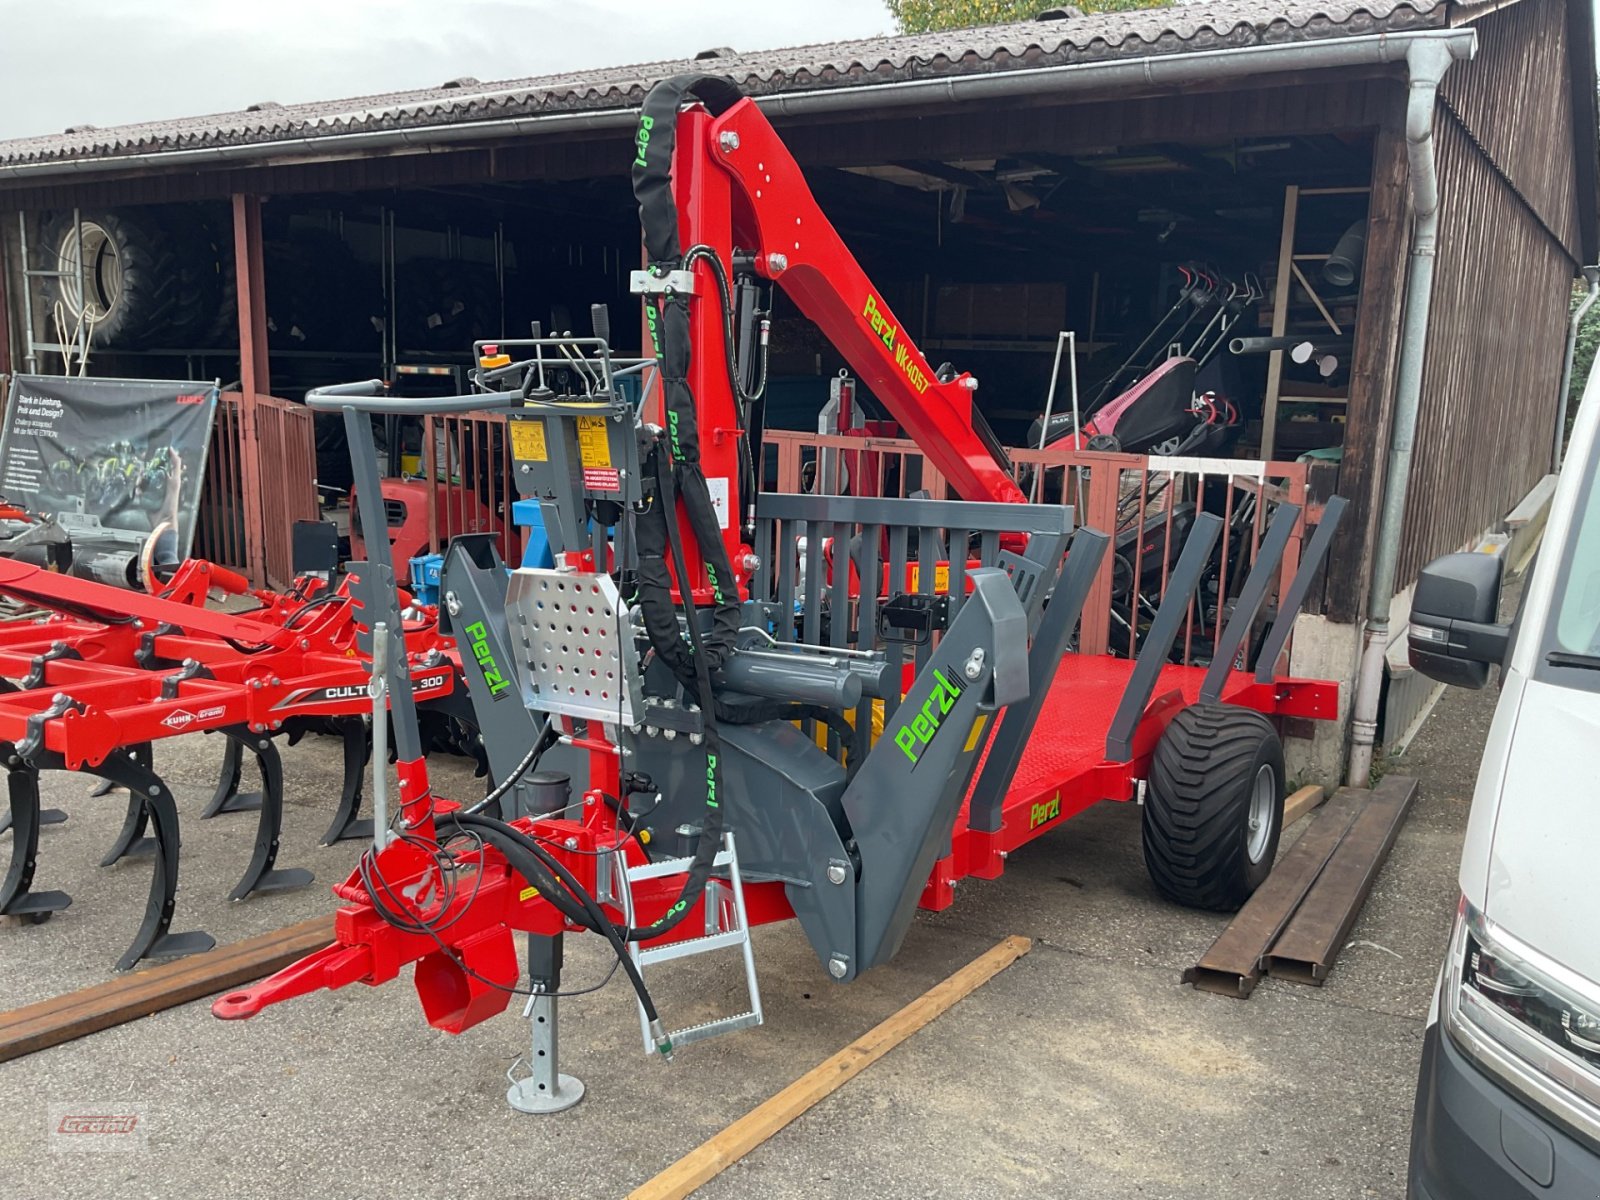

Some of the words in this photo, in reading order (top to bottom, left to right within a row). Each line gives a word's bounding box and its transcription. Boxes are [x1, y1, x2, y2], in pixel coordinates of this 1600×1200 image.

[635, 115, 654, 168] Perzl
[646, 305, 662, 359] Perzl
[865, 293, 897, 352] Perzl
[29, 407, 41, 416] und
[667, 409, 686, 462] Perzl
[703, 562, 725, 606] Perzl
[420, 676, 443, 689] 300
[465, 620, 511, 696] Perzl
[166, 714, 191, 726] KUHN
[894, 668, 962, 764] Perzl
[706, 754, 720, 808] Perzl
[1030, 792, 1061, 830] Perzl
